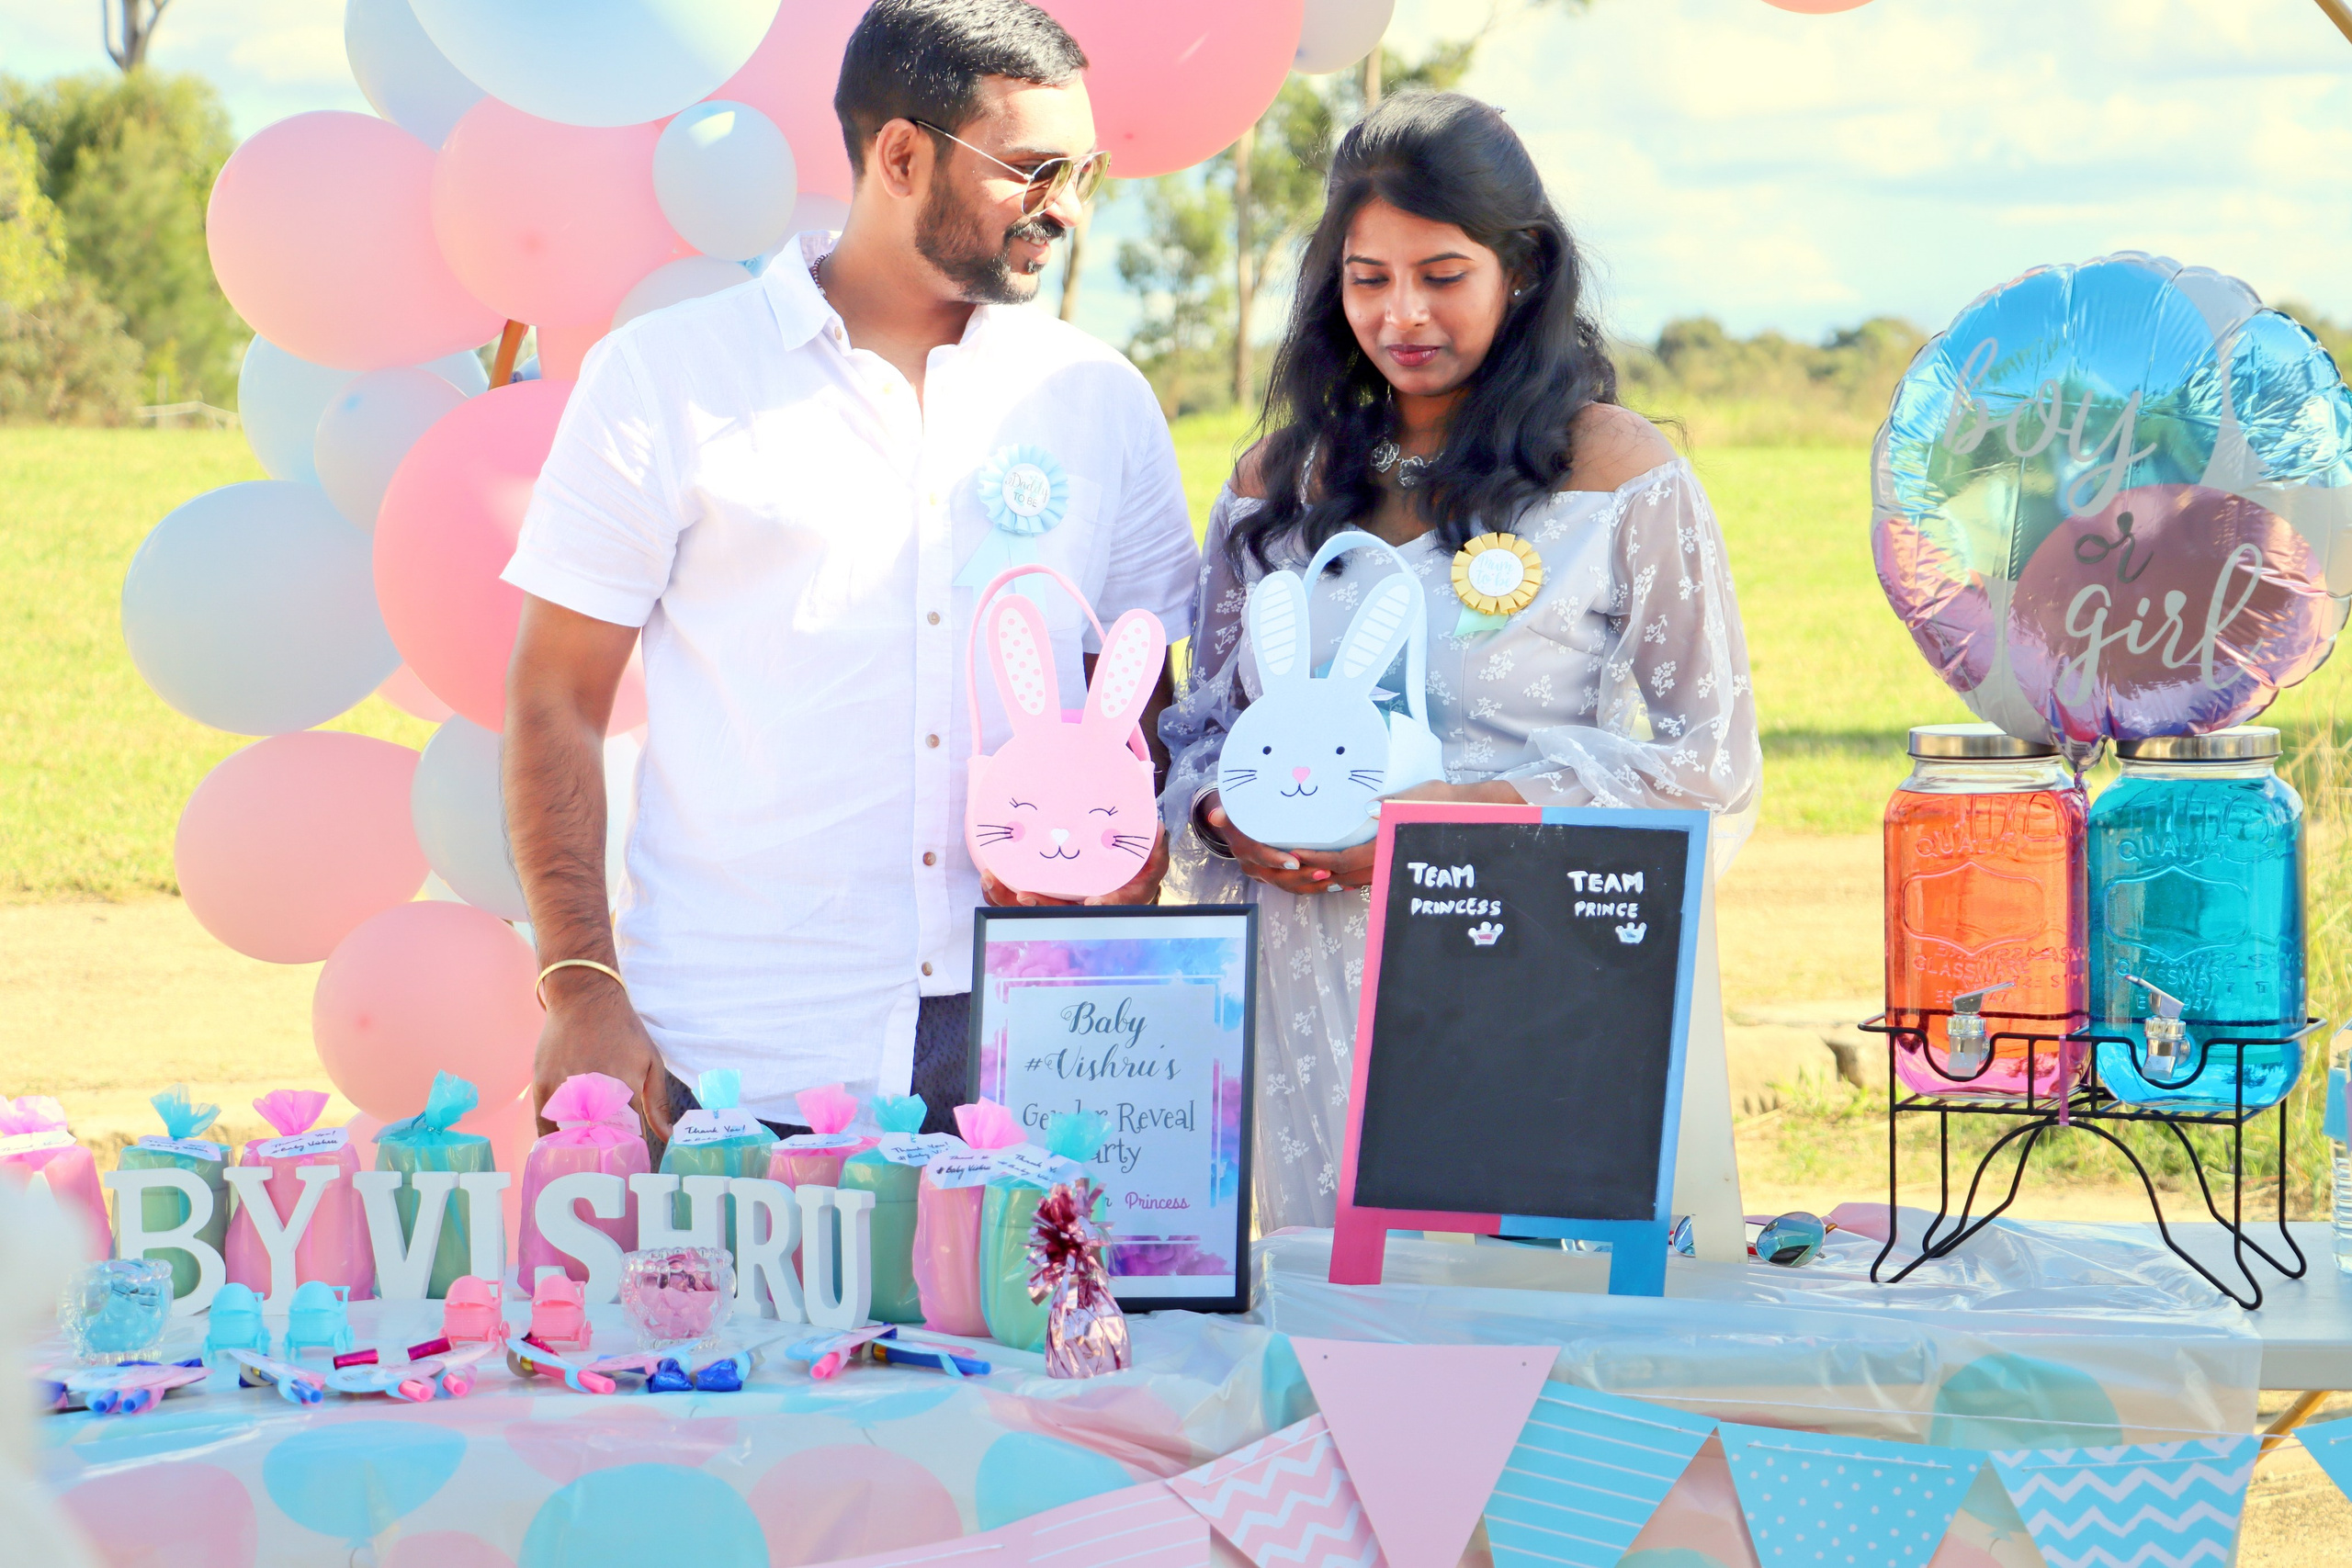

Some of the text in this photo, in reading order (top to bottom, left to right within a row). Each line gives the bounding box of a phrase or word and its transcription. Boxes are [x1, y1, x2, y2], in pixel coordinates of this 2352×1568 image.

[1943, 337, 2157, 517] boy
[1004, 471, 1049, 503] Daddy
[1013, 491, 1037, 507] TO BE
[2075, 511, 2154, 582] or
[2058, 543, 2264, 707] girl
[1407, 862, 1476, 888] TEAM
[1566, 870, 1645, 894] TEAM
[1410, 897, 1503, 917] PRINCESS
[1574, 900, 1639, 919] PRINCE
[1060, 997, 1148, 1048] Baby
[685, 1126, 718, 1134] Thank
[1116, 1100, 1195, 1134] Reveal
[1125, 1191, 1191, 1210] Princess
